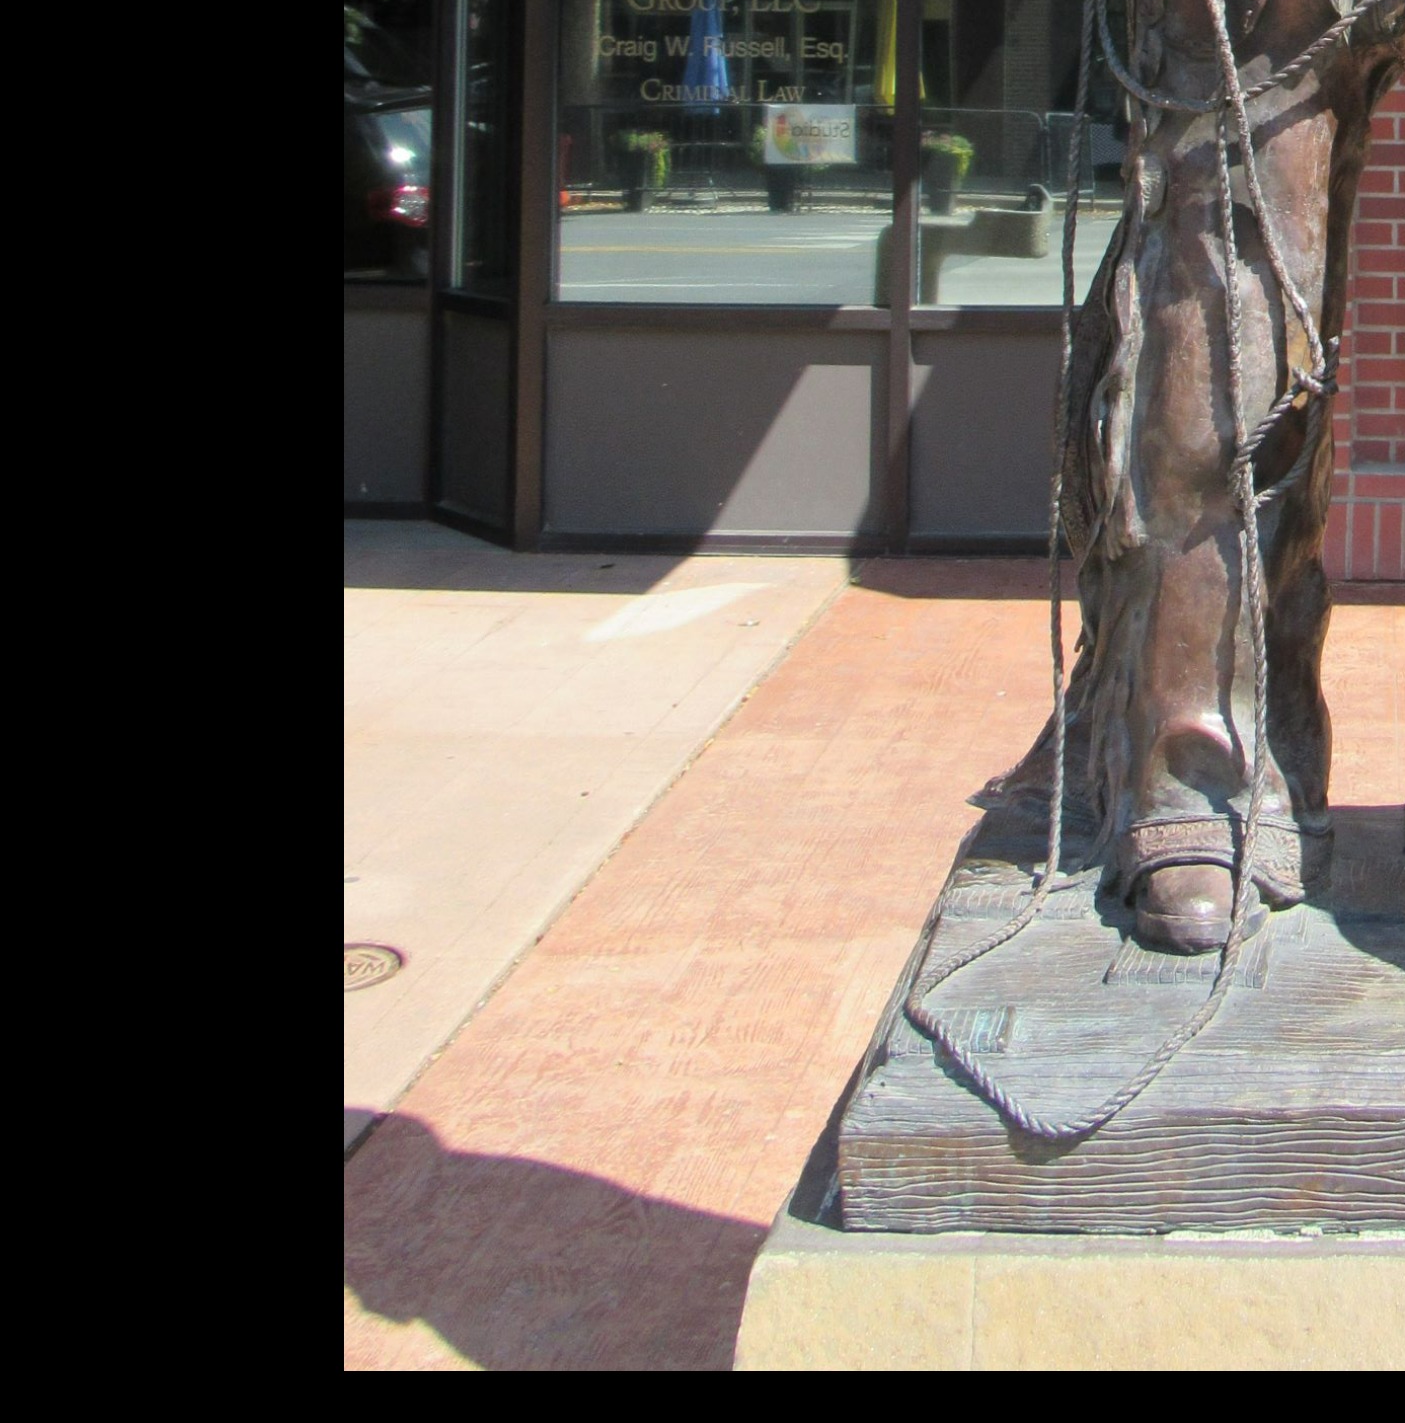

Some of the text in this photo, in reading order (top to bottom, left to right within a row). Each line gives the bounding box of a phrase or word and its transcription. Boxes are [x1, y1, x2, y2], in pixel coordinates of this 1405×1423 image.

[599, 35, 849, 64] Craig W. Russell, Esq.
[757, 79, 807, 103] LAW
[344, 961, 386, 976] WA
